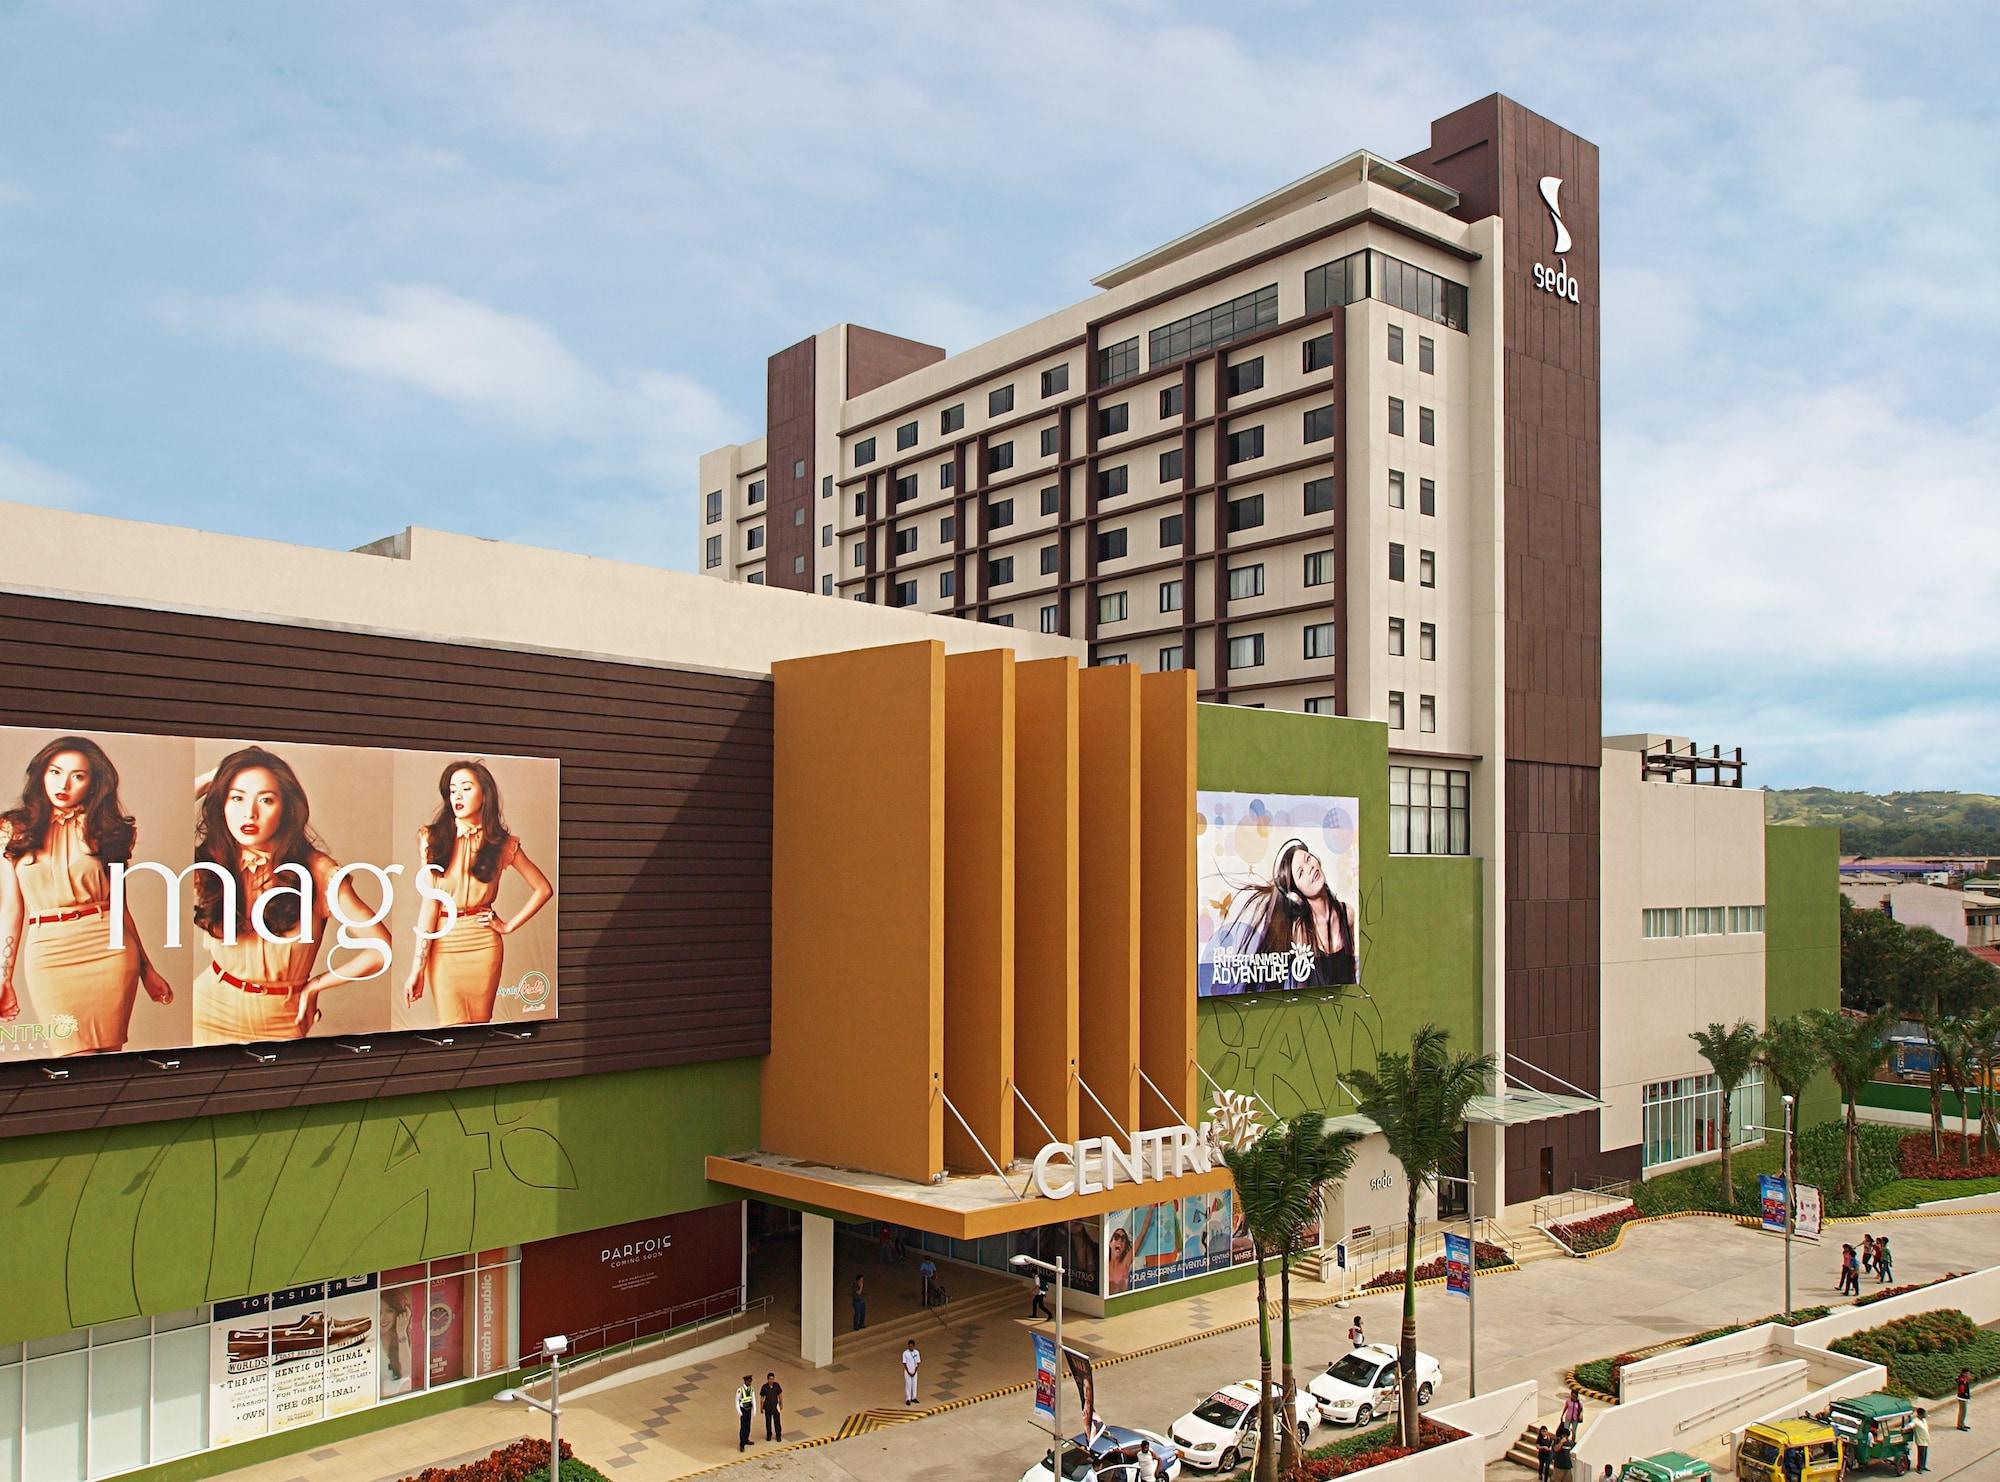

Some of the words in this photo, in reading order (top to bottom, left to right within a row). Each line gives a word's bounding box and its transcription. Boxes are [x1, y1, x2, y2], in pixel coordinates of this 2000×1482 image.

[1533, 257, 1580, 304] seda
[108, 861, 457, 981] mags
[1212, 963, 1289, 984] ADVENTURE
[1213, 951, 1290, 969] ENTERTAINMENT
[1032, 1121, 1228, 1200] CENTRI
[601, 1234, 672, 1263] PARFOIS
[610, 1256, 641, 1269] COMING
[643, 1251, 663, 1261] SOON
[481, 1274, 494, 1328] republic
[481, 1332, 492, 1371] watch
[227, 1377, 248, 1389] THE
[276, 1400, 298, 1412] THE
